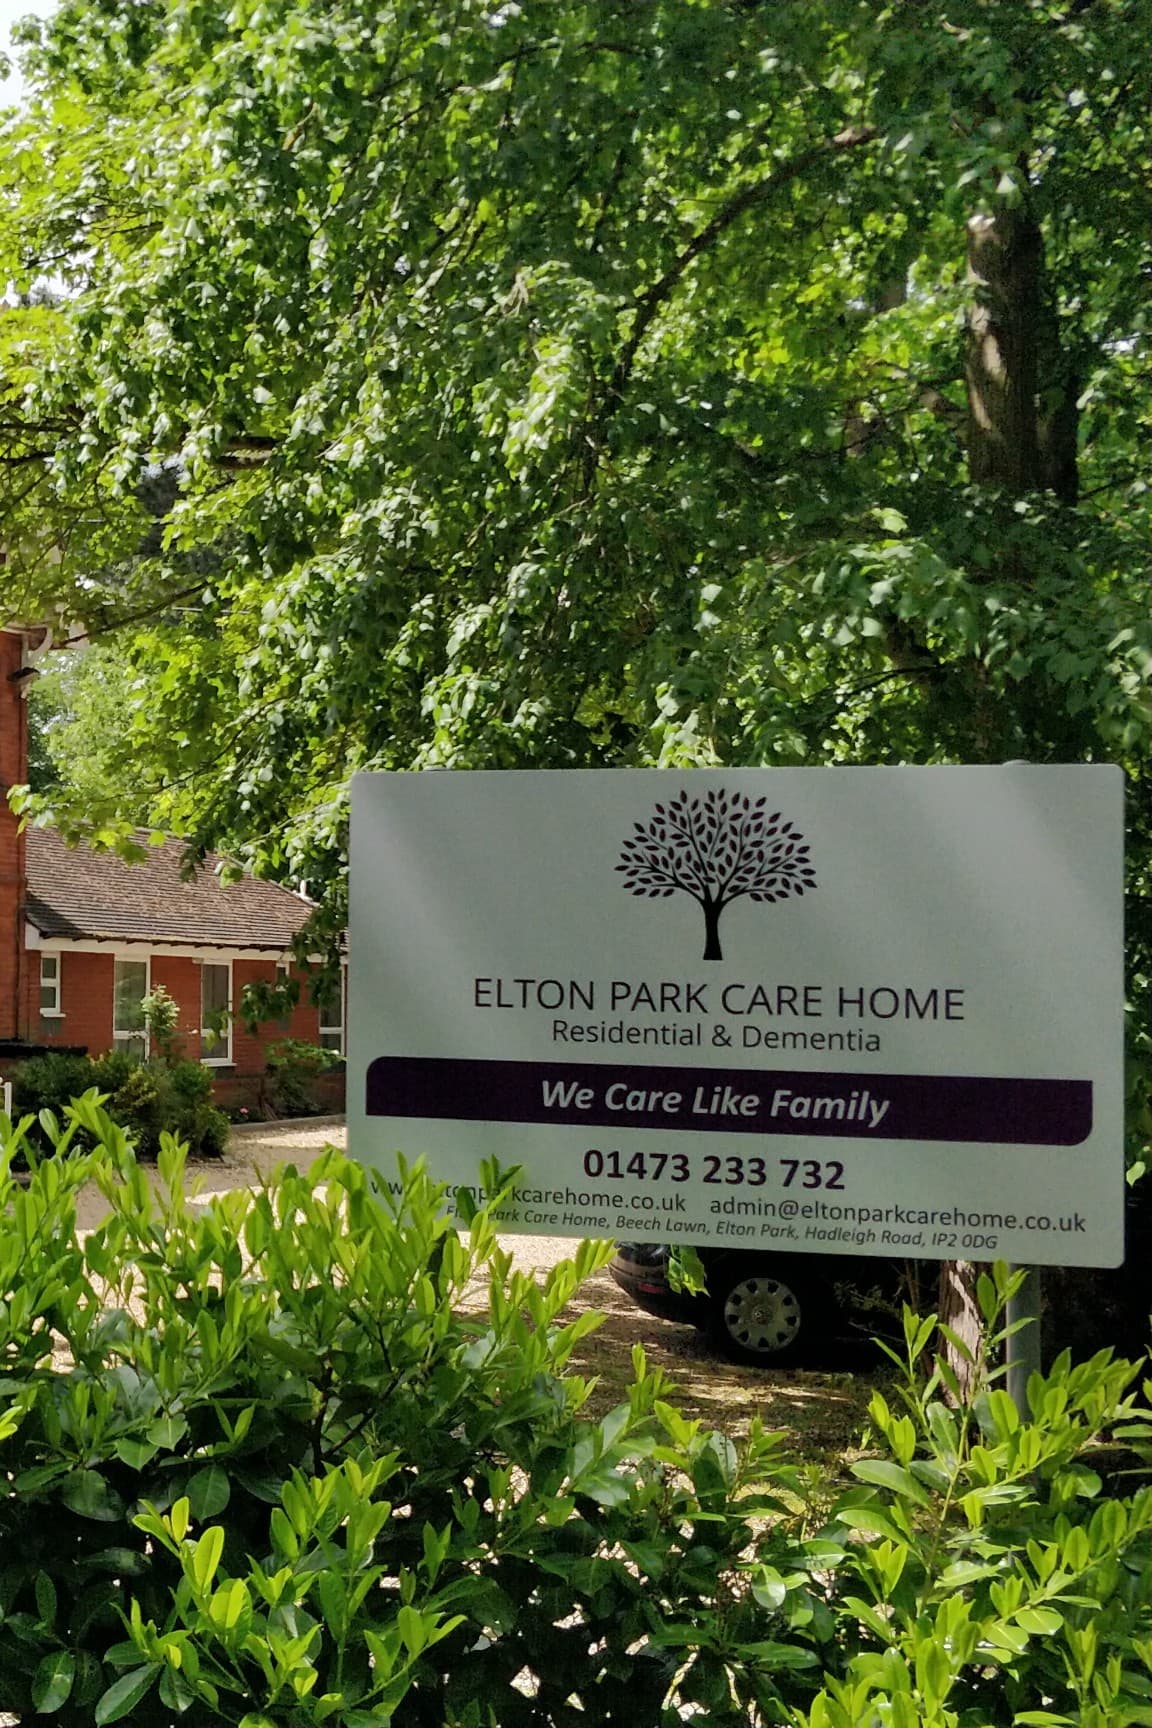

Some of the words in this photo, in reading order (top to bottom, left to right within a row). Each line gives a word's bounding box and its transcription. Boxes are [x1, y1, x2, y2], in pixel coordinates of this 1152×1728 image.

[474, 978, 594, 1010] ELTON
[611, 981, 708, 1013] PARK
[721, 984, 822, 1017] CARE
[838, 987, 964, 1020] HOME
[552, 1020, 701, 1047] Residential
[711, 1024, 732, 1047] &
[742, 1025, 881, 1051] Dementia
[542, 1080, 594, 1109] We
[605, 1083, 682, 1114] Care
[692, 1086, 760, 1117] Like
[770, 1089, 890, 1129] Family
[583, 1149, 690, 1182] 01473
[702, 1155, 767, 1186] 233
[779, 1159, 845, 1190] 732
[524, 1209, 558, 1224] Care
[562, 1212, 610, 1229] Home,
[616, 1214, 661, 1231] Beech
[666, 1218, 710, 1235] Lawn,
[716, 1220, 755, 1236] Elton
[760, 1223, 799, 1240] Park,
[805, 1225, 876, 1245] Hadleigh
[881, 1229, 926, 1248] Road,
[931, 1232, 957, 1248] IP2
[709, 1197, 1086, 1233] admin@eltonparkcarehome.co.uk
